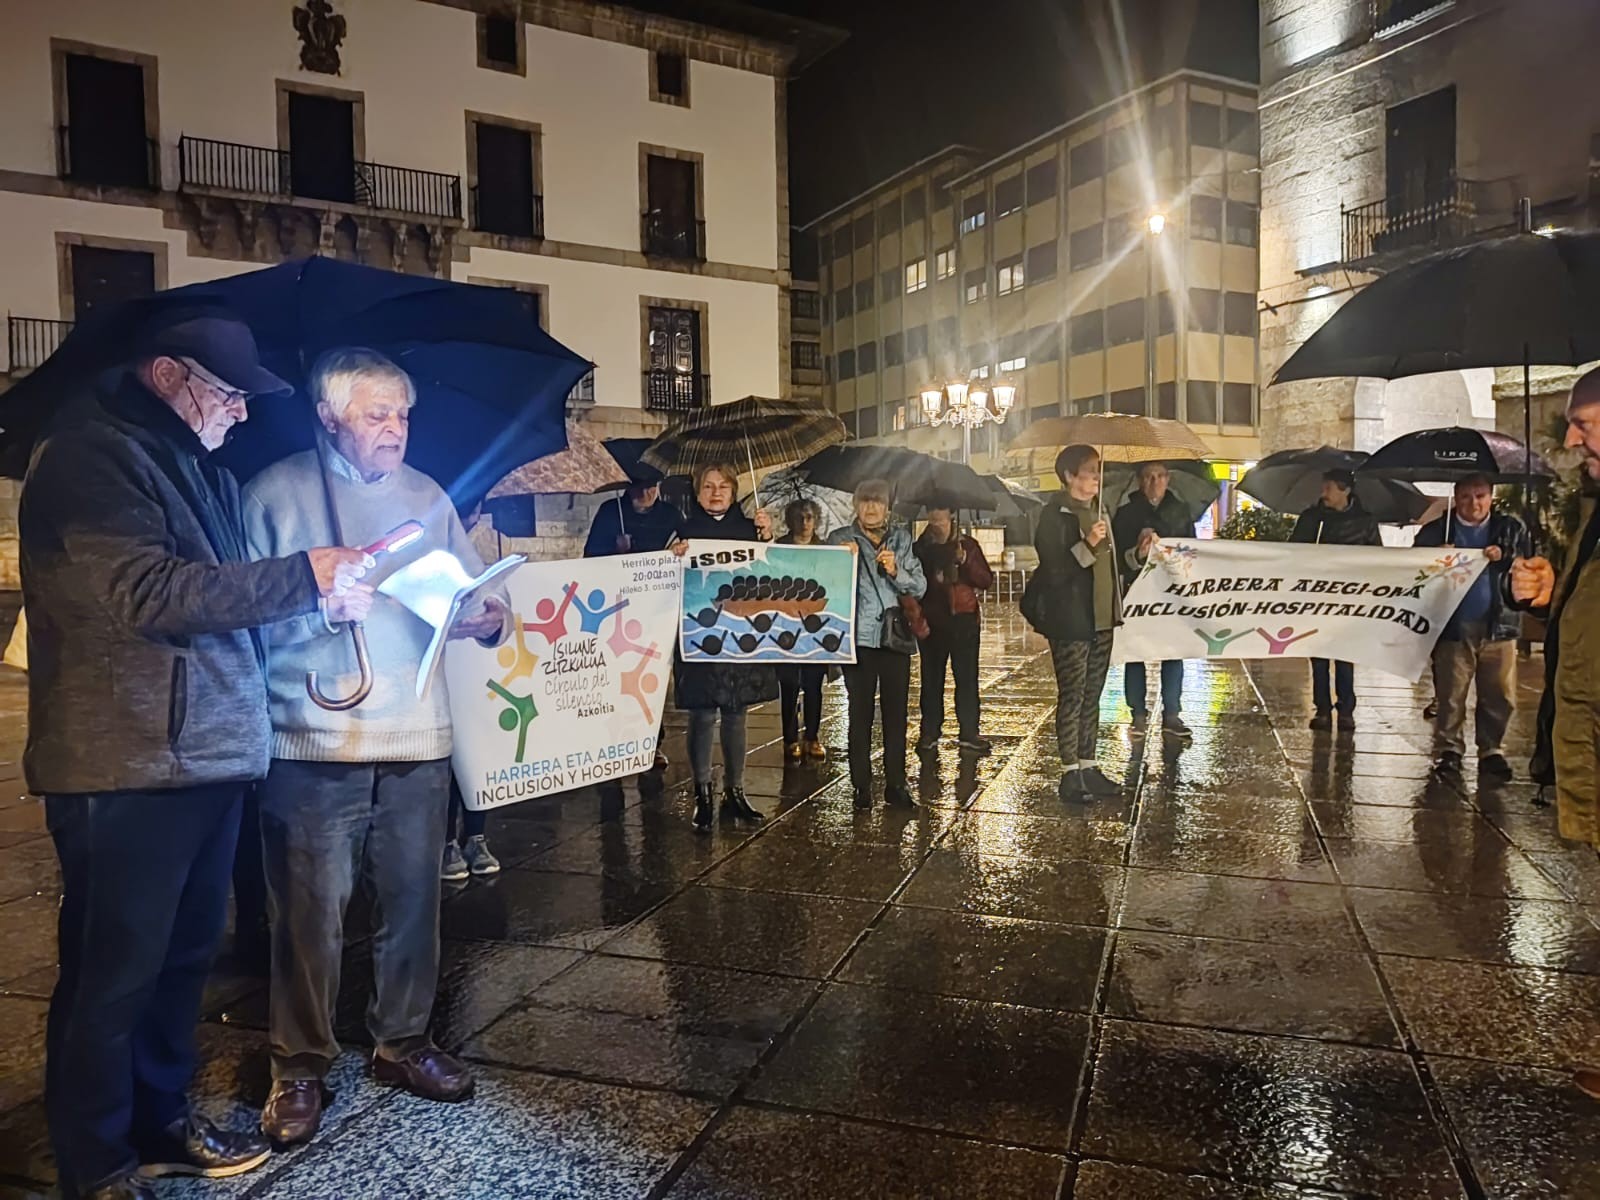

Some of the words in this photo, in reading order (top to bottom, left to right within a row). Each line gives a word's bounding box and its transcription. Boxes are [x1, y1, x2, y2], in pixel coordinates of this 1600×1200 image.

[622, 557, 656, 568] Herriko
[690, 548, 755, 569] ¡SOS!
[620, 586, 642, 594] Hileko
[1165, 577, 1283, 597] HARRERA
[1123, 598, 1430, 635] INCLUSIÓN-HOSPITALIDAD
[577, 702, 615, 718] Azkoitia
[485, 757, 563, 786] HARRERA
[566, 750, 594, 769] ETA
[597, 740, 639, 763] ABEGI
[476, 772, 564, 806] INCLUSIÓN
[568, 769, 577, 783] Y
